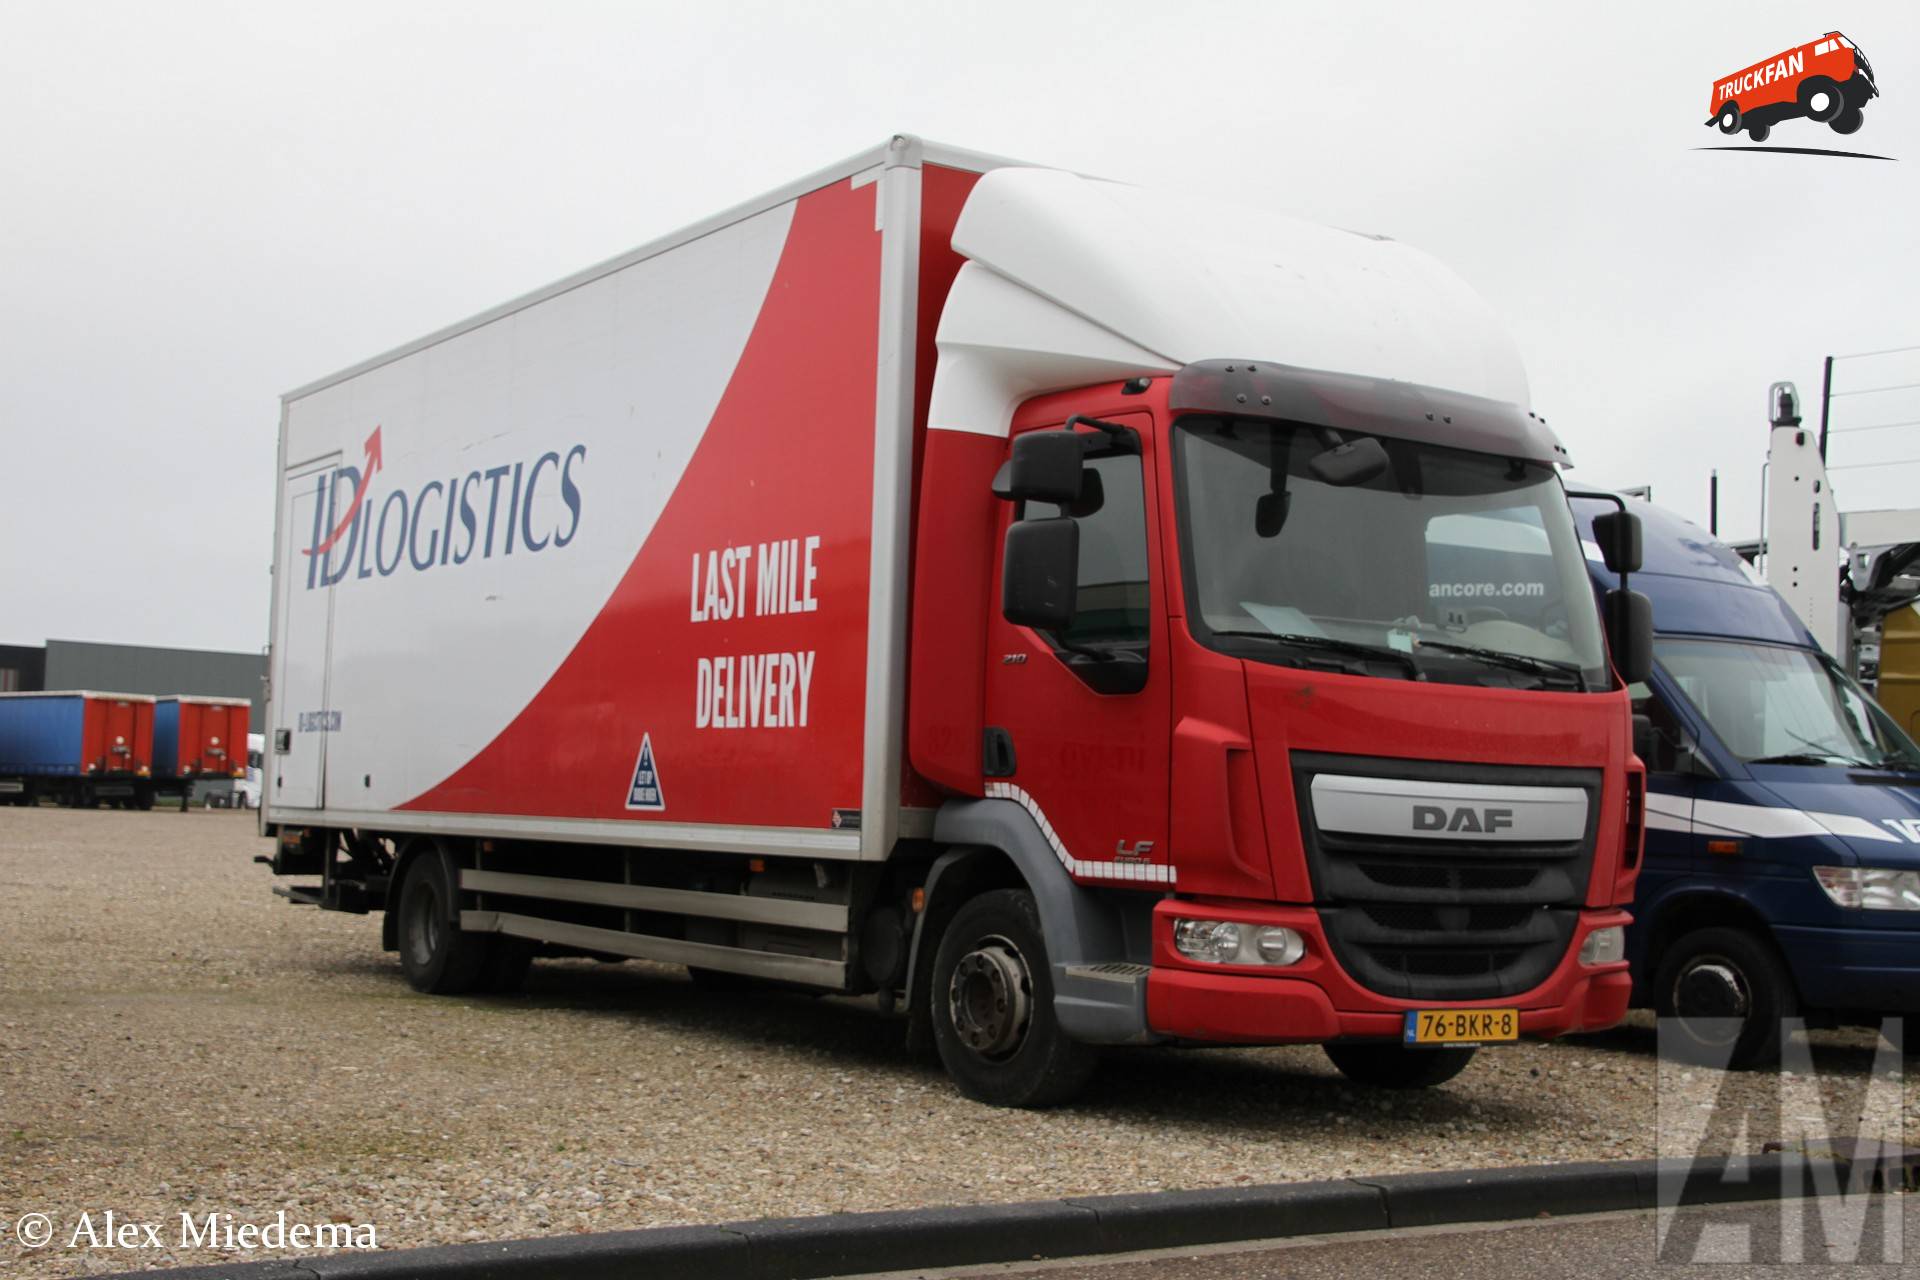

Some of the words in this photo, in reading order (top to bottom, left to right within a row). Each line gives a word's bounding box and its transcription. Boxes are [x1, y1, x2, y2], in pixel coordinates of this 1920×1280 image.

[690, 545, 752, 623] LAST
[755, 535, 820, 617] MILE
[1428, 581, 1545, 598] ancore.com
[695, 650, 816, 729] DELIVERY
[1412, 805, 1513, 833] DAF
[1116, 839, 1155, 856] LF
[1423, 1013, 1512, 1038] 76-BKR-8
